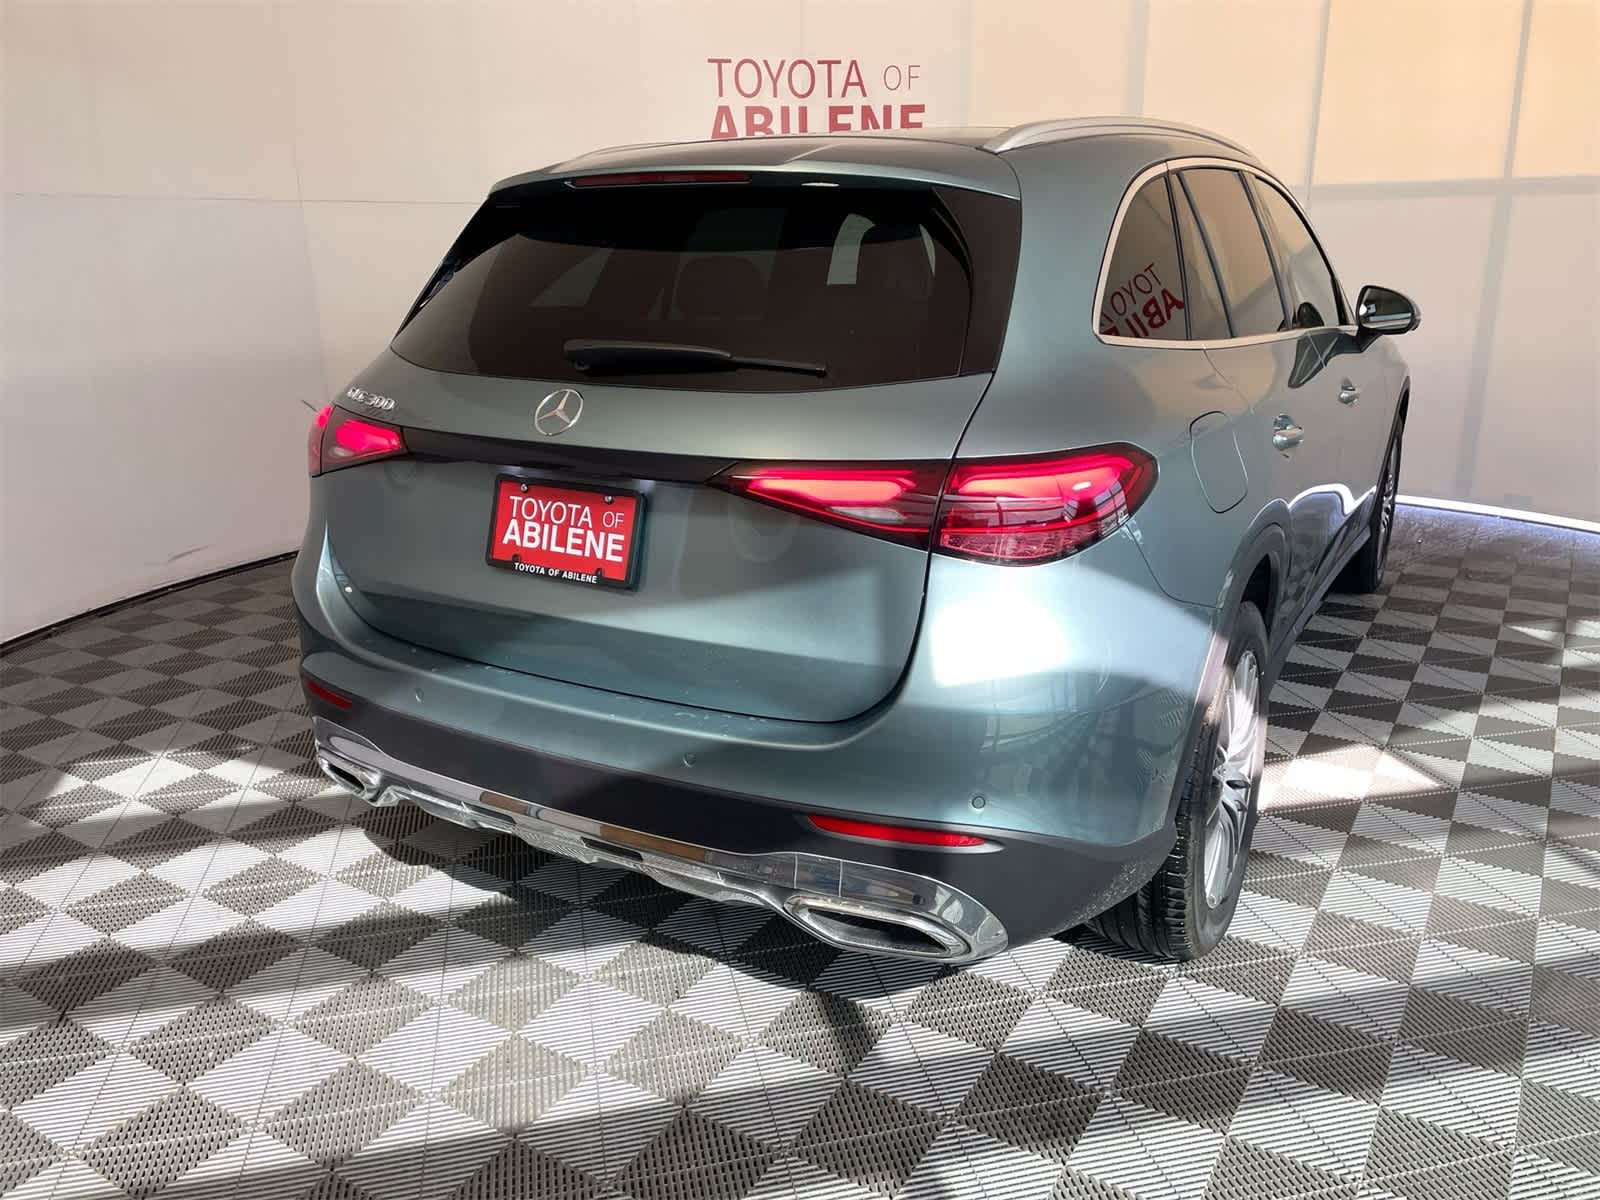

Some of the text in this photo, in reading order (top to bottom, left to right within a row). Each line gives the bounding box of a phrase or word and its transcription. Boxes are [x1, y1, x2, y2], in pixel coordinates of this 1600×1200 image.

[707, 58, 920, 98] TOYOTA OF
[365, 394, 395, 410] 300
[509, 495, 625, 528] TOYOTA OF
[502, 519, 625, 562] ABILENE
[514, 562, 597, 584] TOYOTA OF ABILENE
